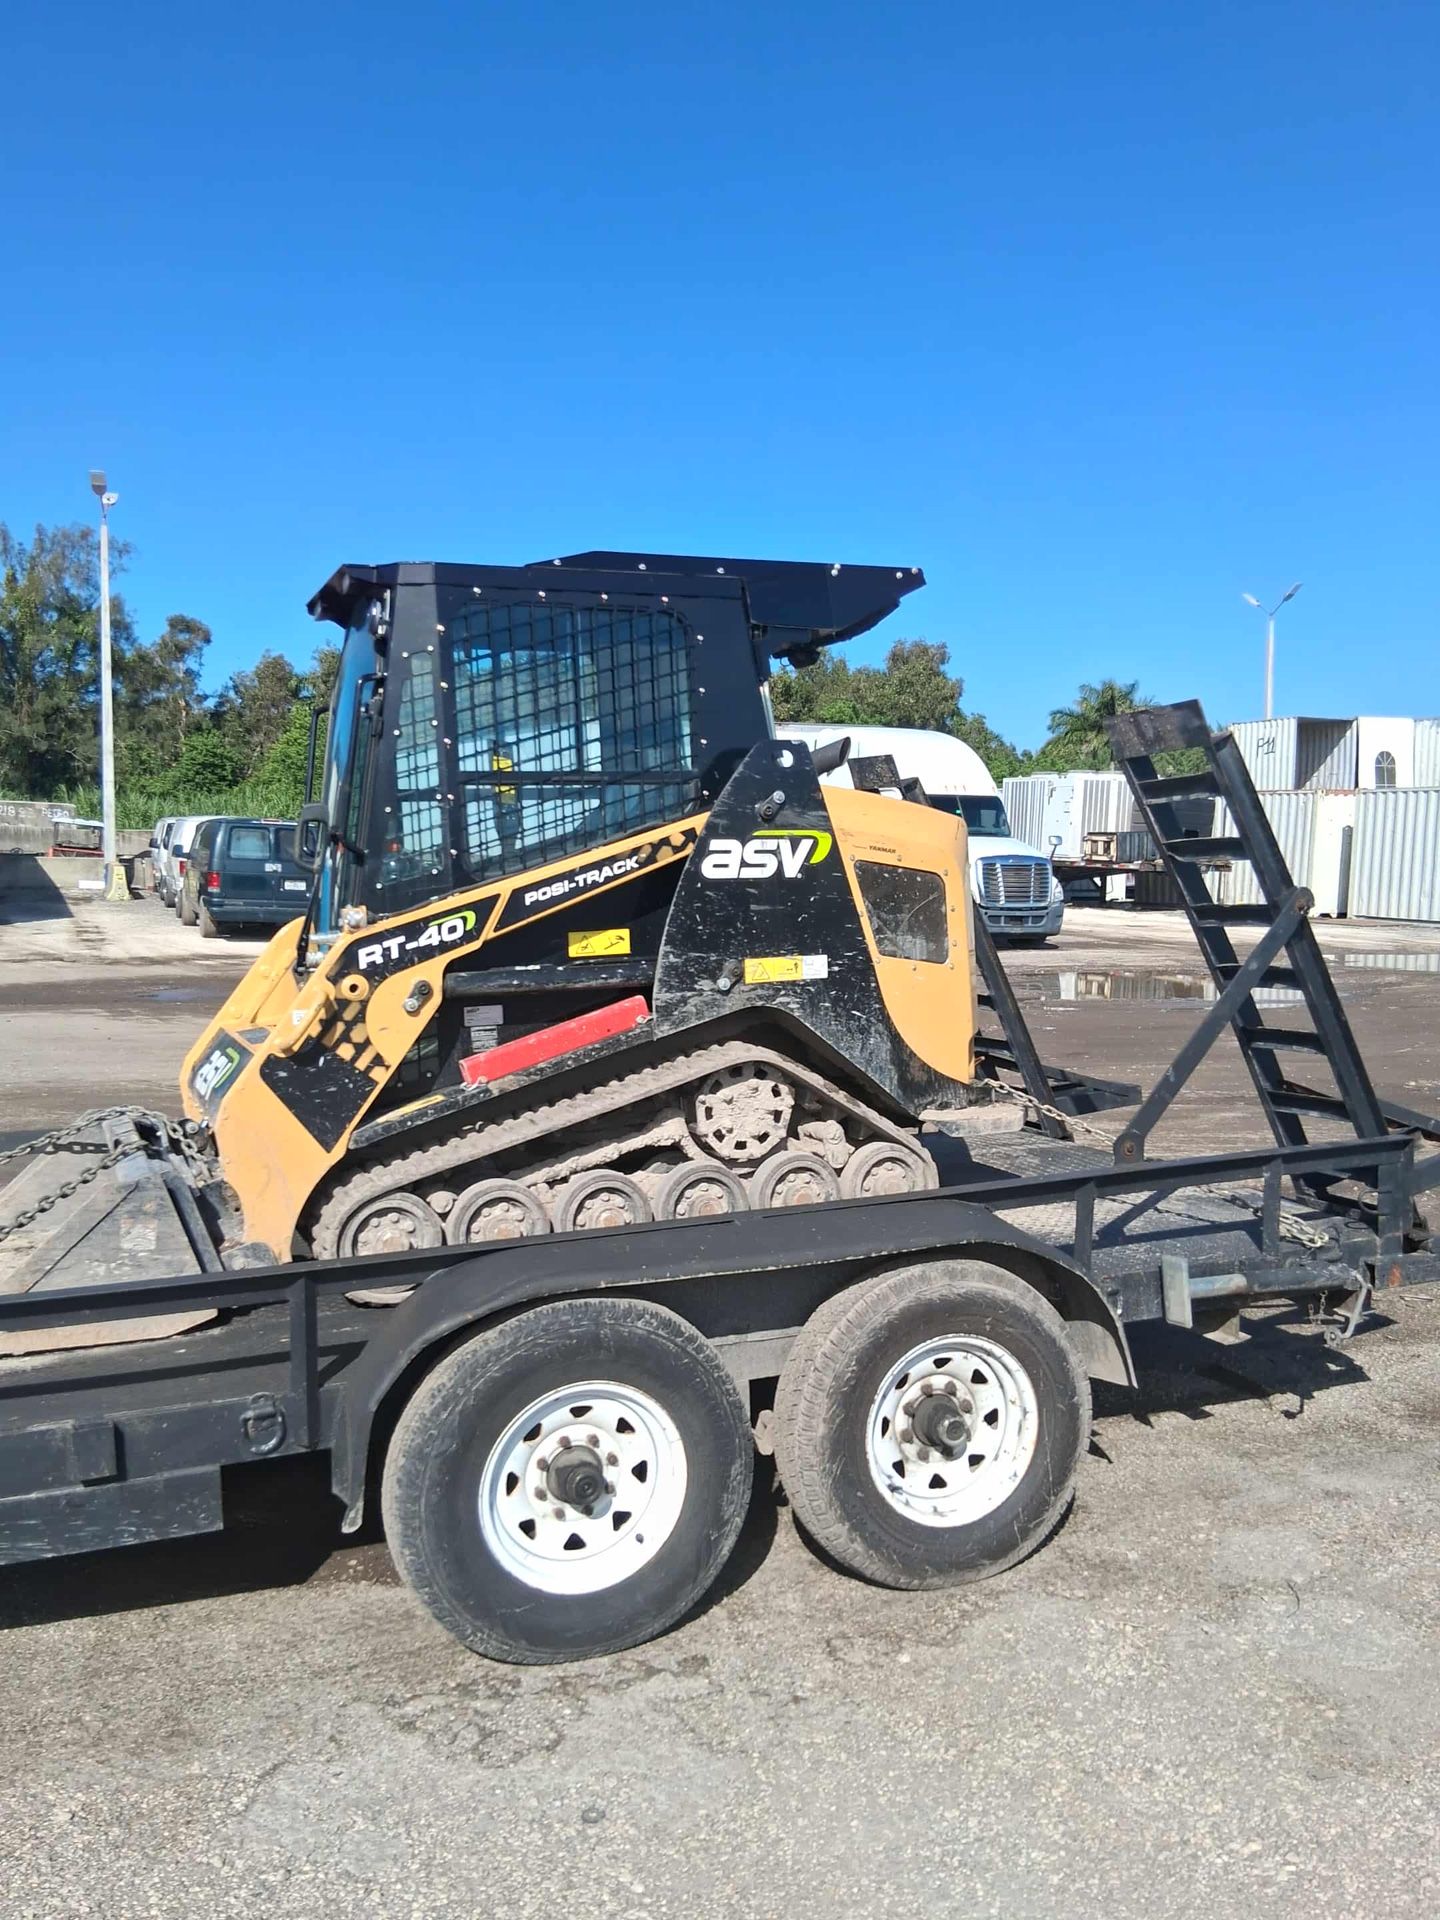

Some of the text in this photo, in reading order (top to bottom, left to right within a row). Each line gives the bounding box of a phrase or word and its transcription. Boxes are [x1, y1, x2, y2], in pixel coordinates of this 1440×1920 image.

[869, 845, 896, 854] YANMAR
[524, 855, 640, 906] POSI-TRACK
[357, 917, 465, 970] RT-40
